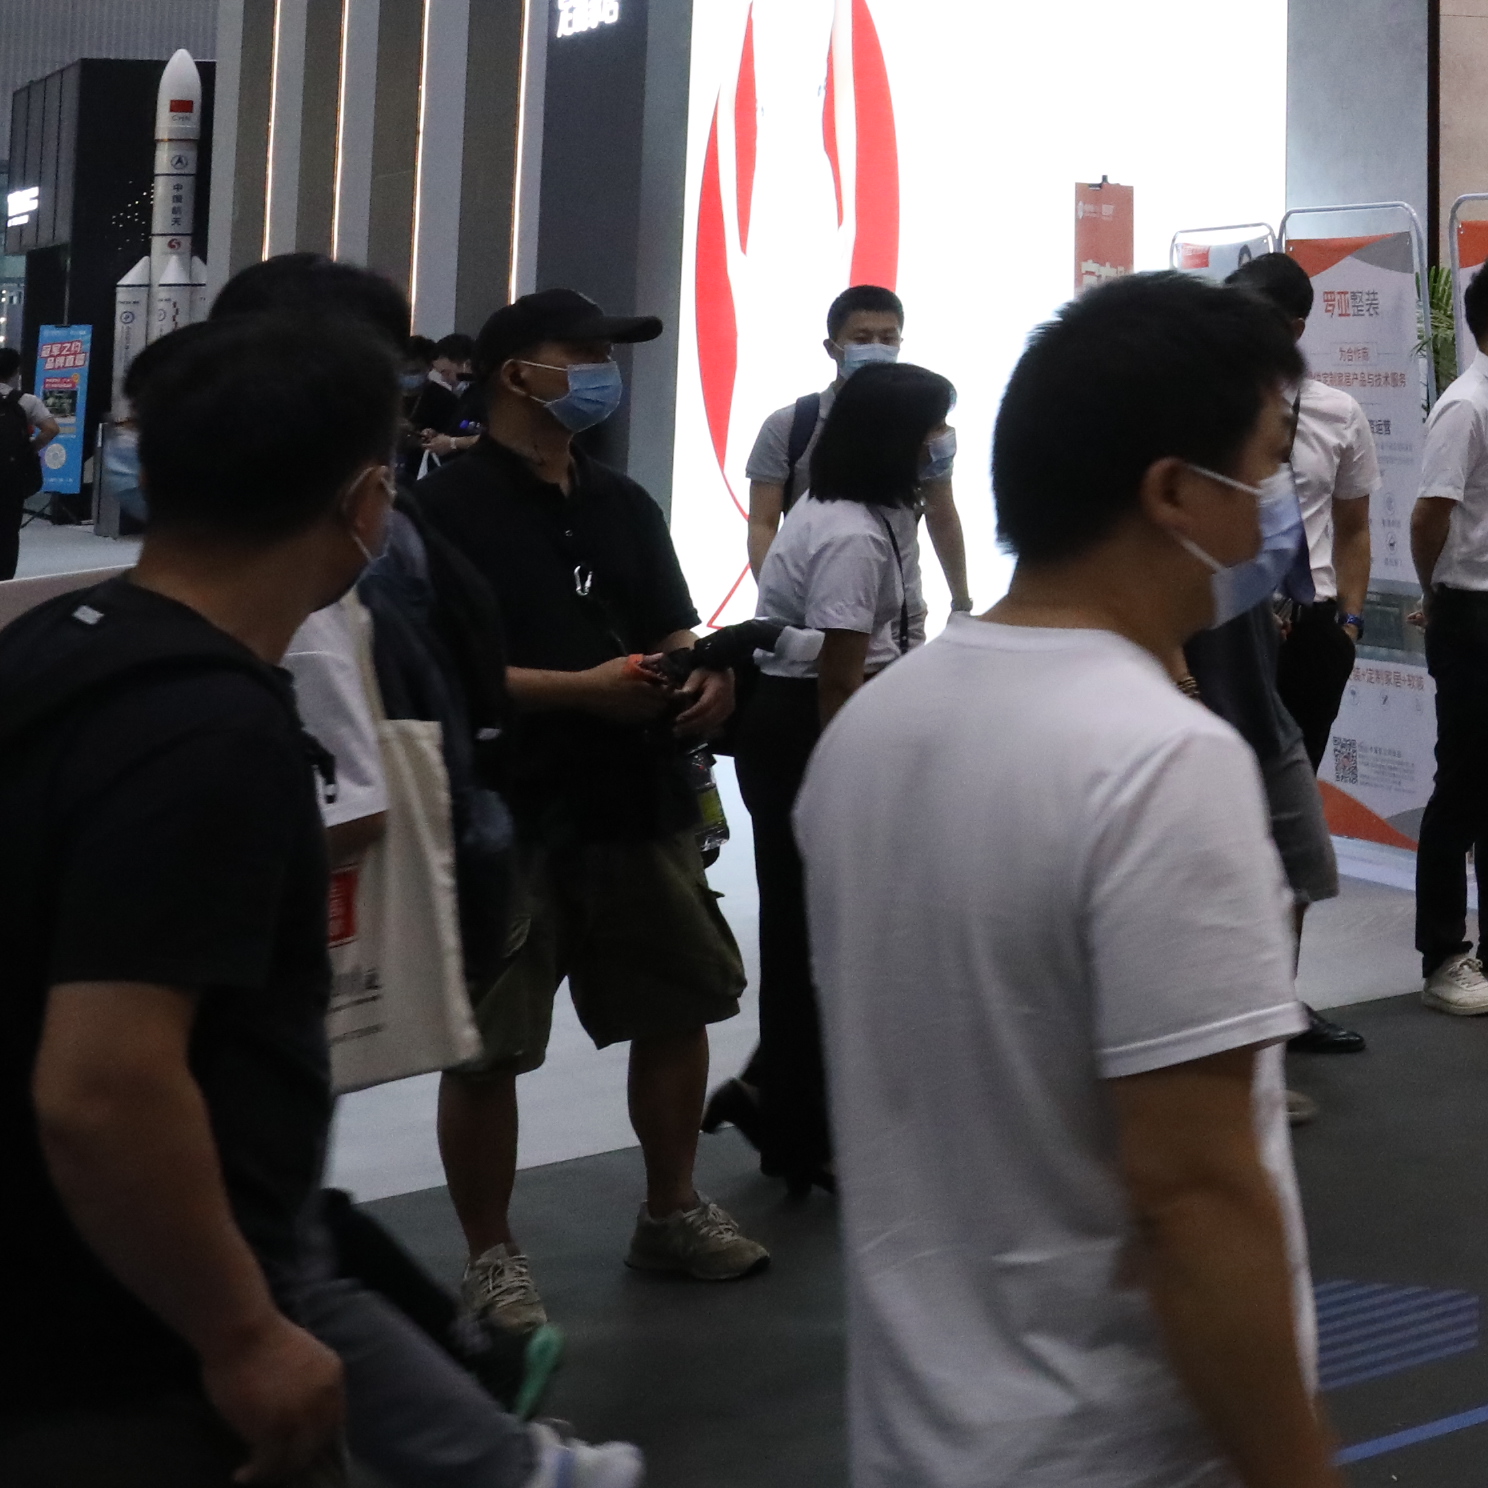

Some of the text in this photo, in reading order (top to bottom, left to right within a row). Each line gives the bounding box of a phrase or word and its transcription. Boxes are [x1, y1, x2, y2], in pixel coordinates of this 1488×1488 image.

[1322, 290, 1380, 318] 罗亚整装
[1308, 371, 1407, 388] 供定制家居产品与技术服务
